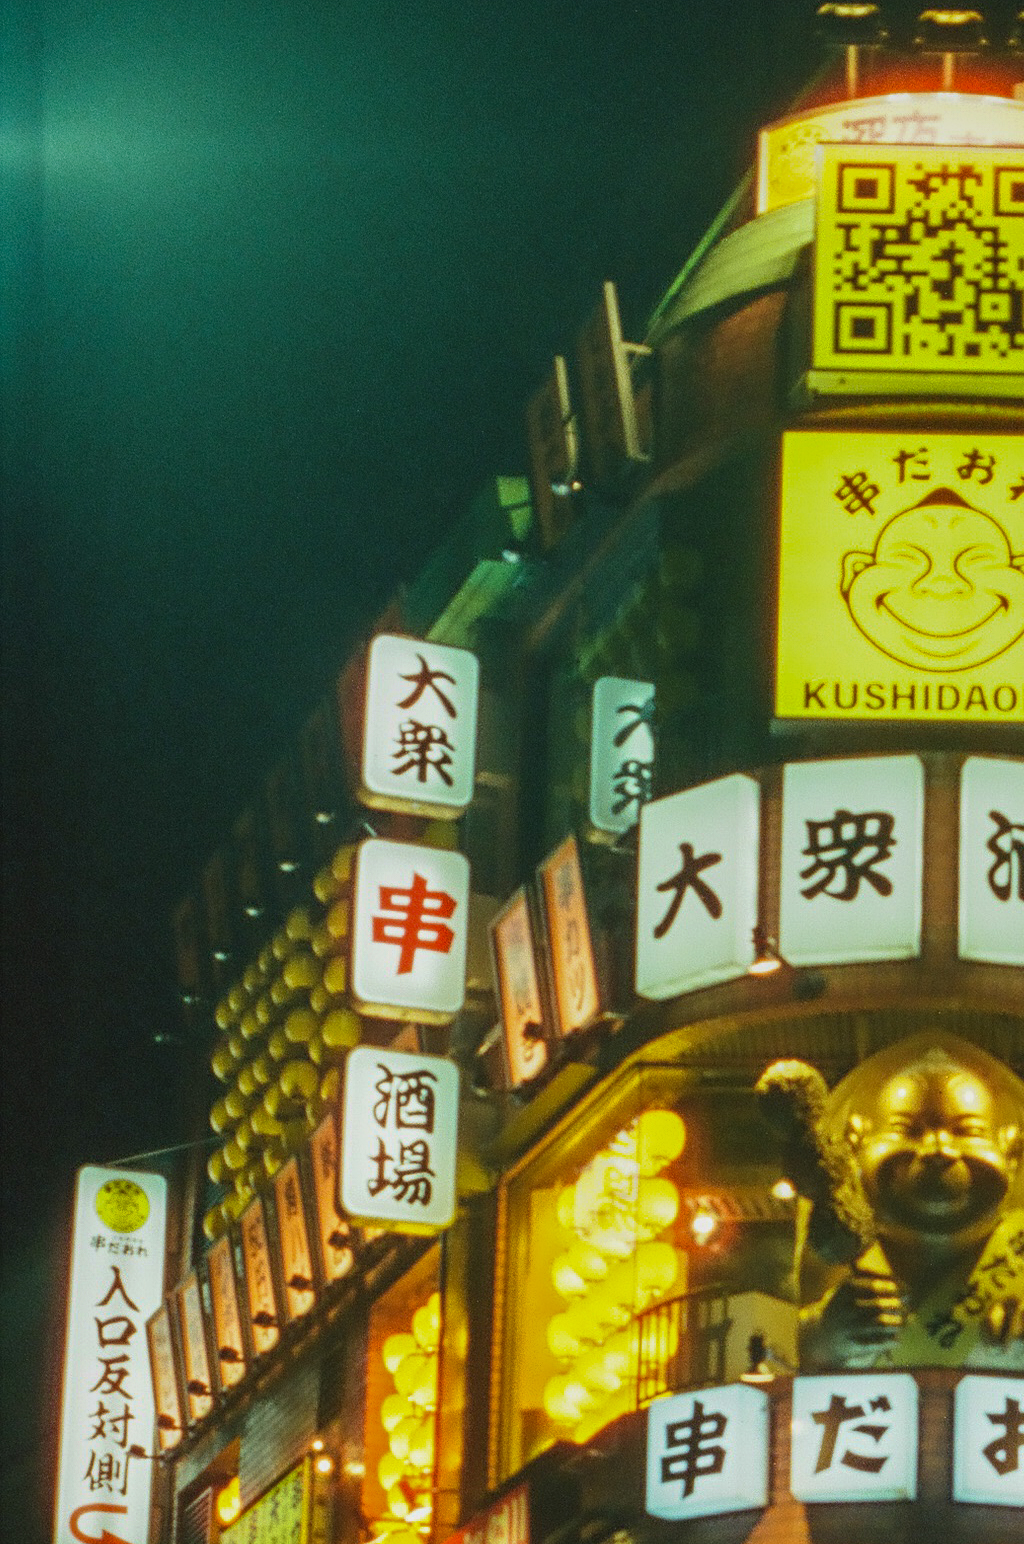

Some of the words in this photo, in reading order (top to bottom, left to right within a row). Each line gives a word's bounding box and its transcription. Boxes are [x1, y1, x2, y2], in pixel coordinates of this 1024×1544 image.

[391, 653, 457, 787] 大衆
[371, 873, 458, 976] 串
[368, 1064, 437, 1207] 酒場
[82, 1265, 142, 1496] 入口反対側
